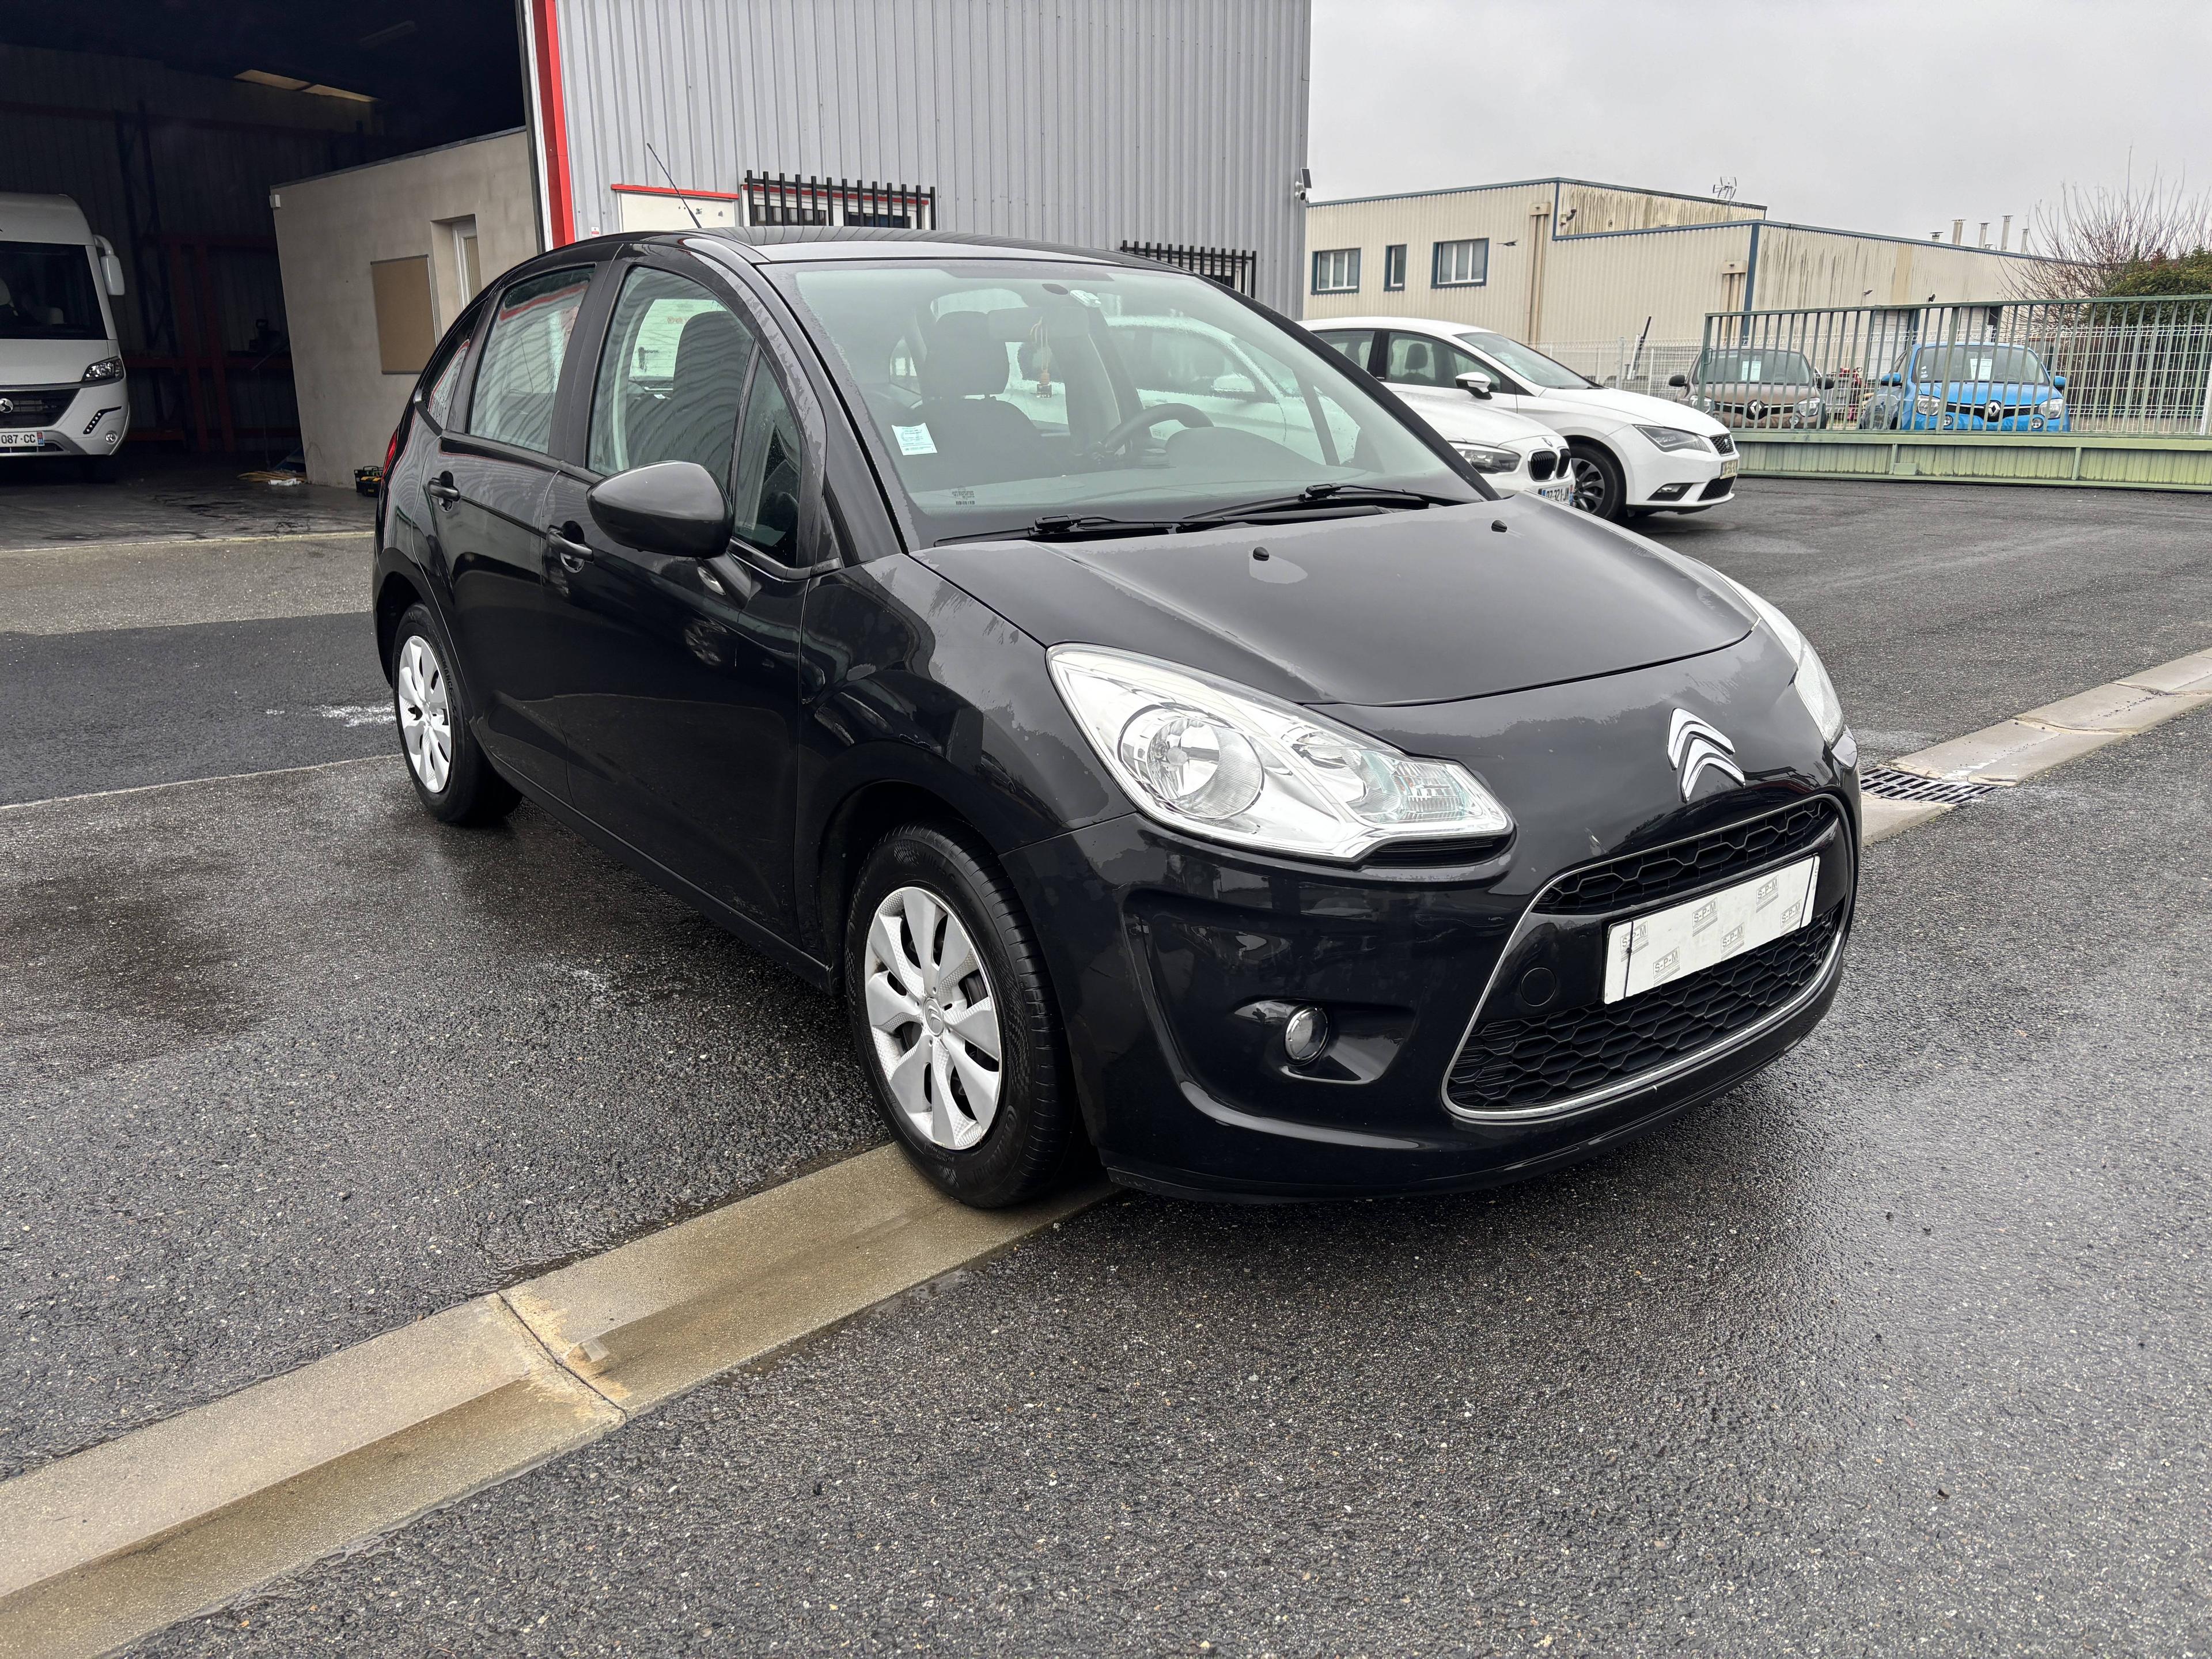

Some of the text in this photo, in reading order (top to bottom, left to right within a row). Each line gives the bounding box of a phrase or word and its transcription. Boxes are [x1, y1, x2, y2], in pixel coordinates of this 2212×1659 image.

[1758, 878, 1778, 899] S-P-M
[1694, 902, 1716, 922] S-P-M
[1722, 926, 1743, 948] S-P-M
[1654, 950, 1678, 973] S-P-M
